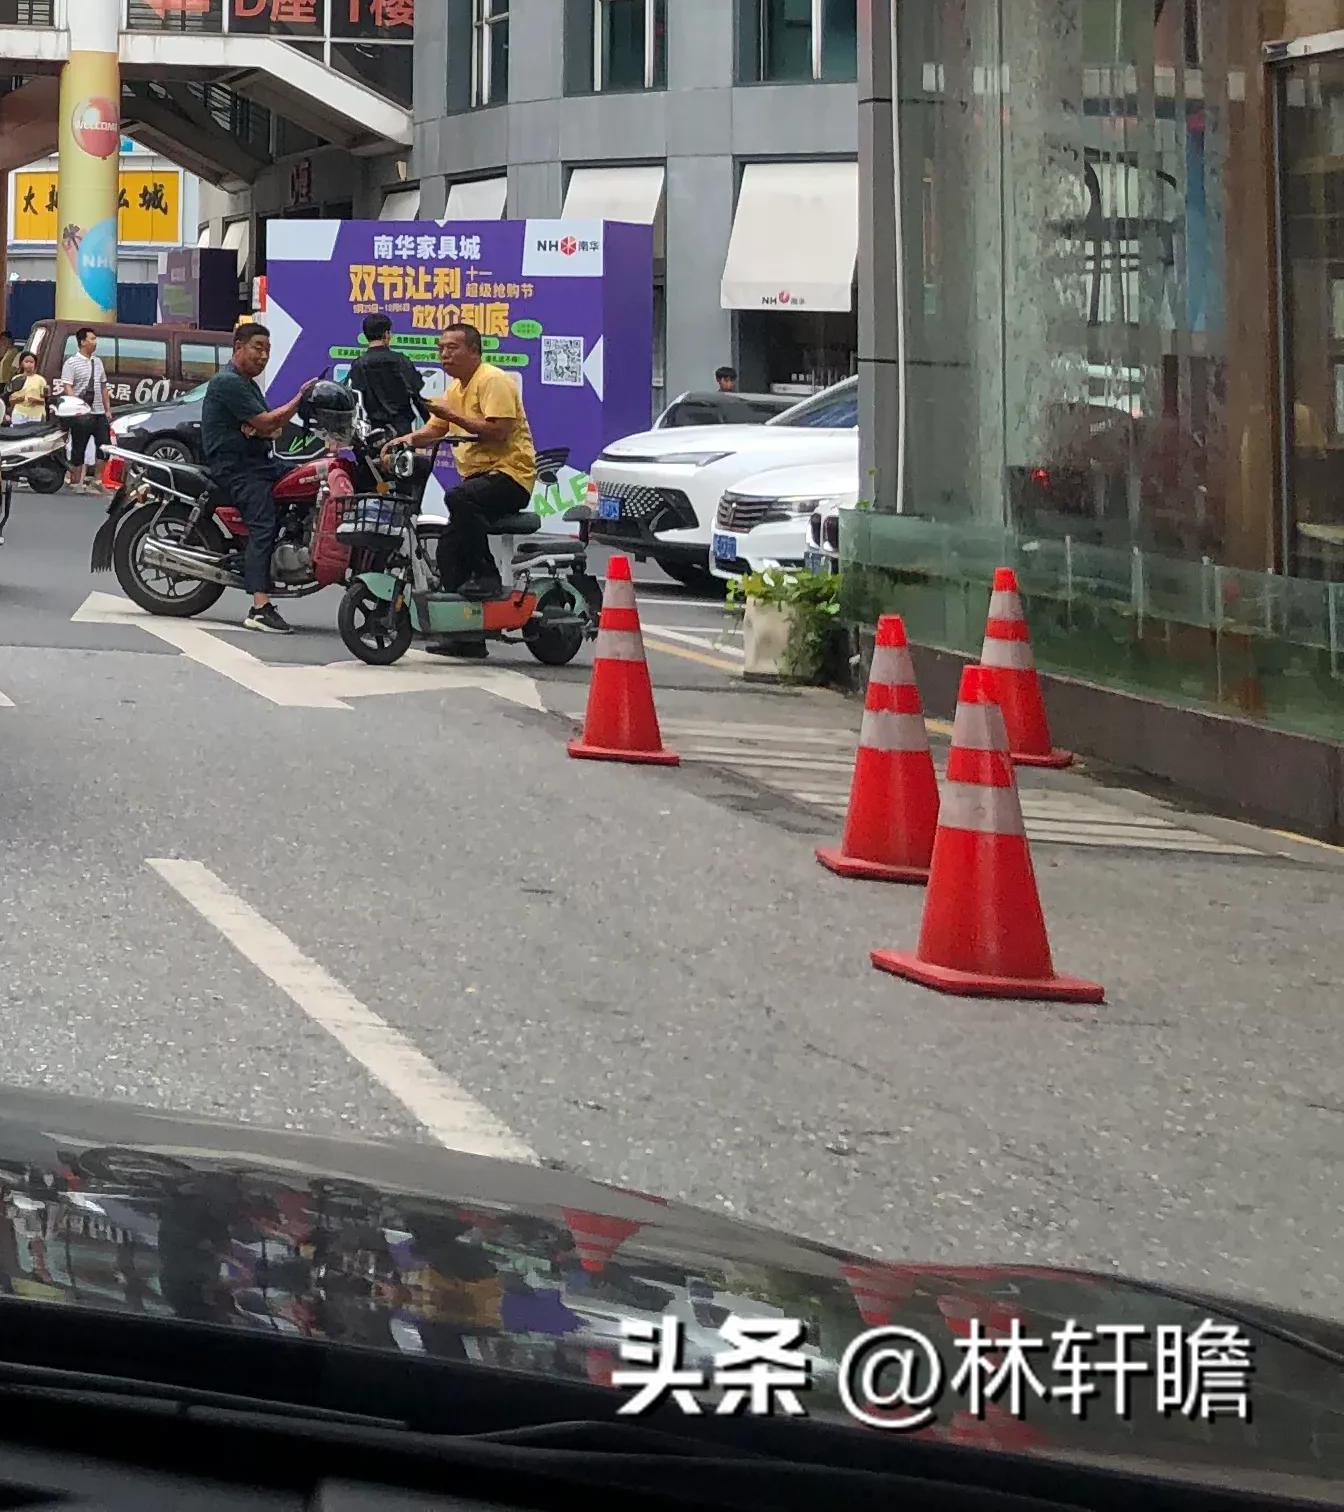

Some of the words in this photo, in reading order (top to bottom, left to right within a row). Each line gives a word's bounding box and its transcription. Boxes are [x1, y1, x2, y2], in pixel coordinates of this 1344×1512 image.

[373, 234, 481, 260] 南华家具城
[537, 240, 559, 252] NH
[349, 264, 461, 302] 双节让利
[412, 302, 510, 337] 放价到底
[533, 472, 588, 518] ALE
